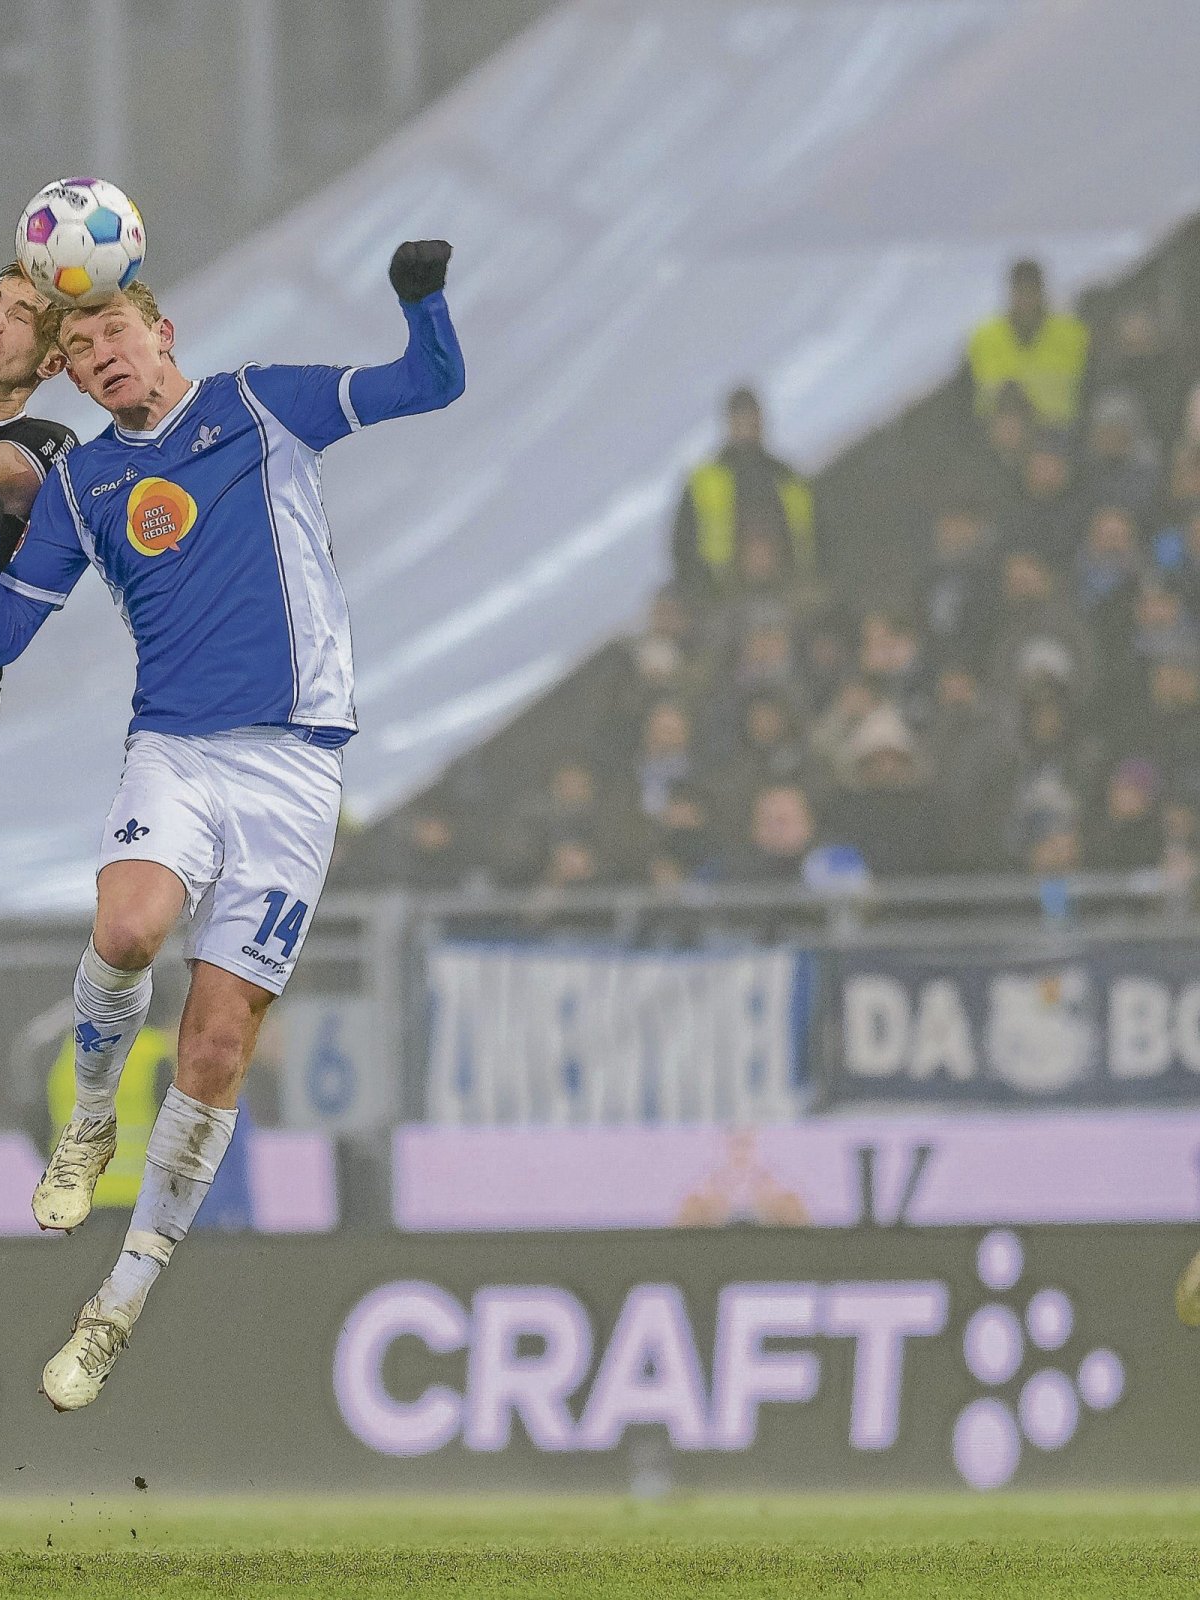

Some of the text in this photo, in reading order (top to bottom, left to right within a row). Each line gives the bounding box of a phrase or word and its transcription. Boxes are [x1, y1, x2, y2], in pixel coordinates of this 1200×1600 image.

[91, 474, 126, 497] CRAF
[143, 523, 176, 540] REDEN
[144, 505, 165, 519] ROT
[253, 890, 308, 959] 14
[241, 945, 283, 970] CRAFT
[844, 973, 976, 1082] DA
[305, 1012, 359, 1117] 6
[332, 1280, 948, 1457] CRAFT
